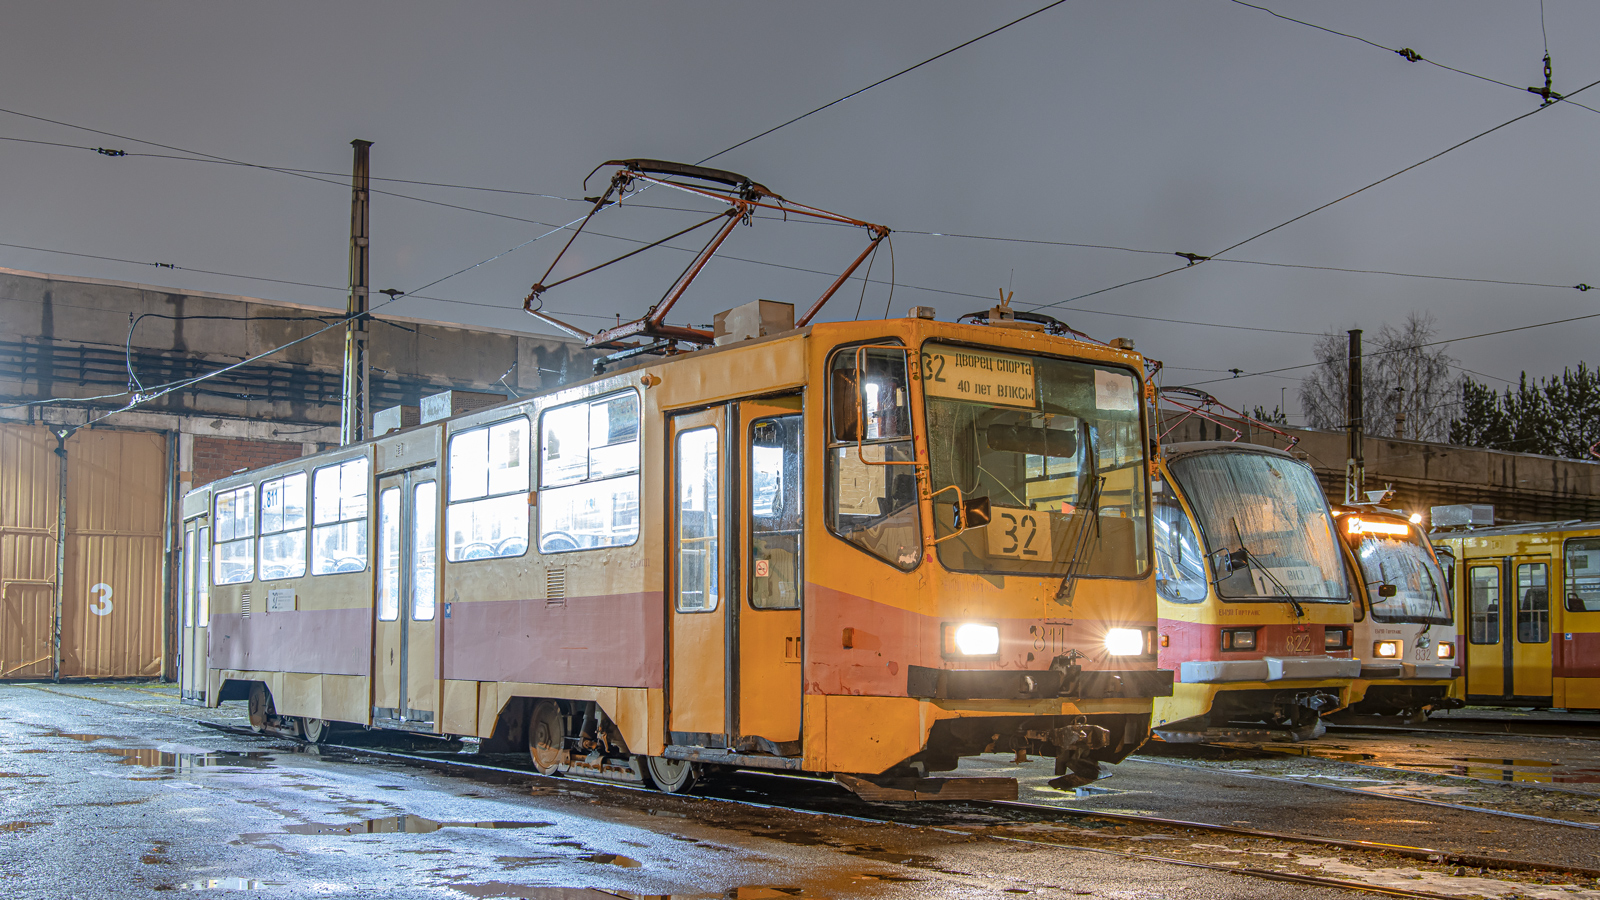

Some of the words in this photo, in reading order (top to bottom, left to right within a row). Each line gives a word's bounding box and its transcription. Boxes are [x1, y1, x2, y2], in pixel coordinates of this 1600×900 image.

[922, 352, 946, 382] 32
[957, 380, 971, 393] 40
[974, 383, 992, 395] лет
[998, 384, 1034, 400] ВЛКСМ
[266, 489, 278, 508] 811
[1001, 513, 1038, 556] 32
[1259, 576, 1267, 595] 1
[90, 582, 113, 616] 3
[1031, 625, 1063, 652] 811
[1286, 634, 1311, 652] 822
[1415, 648, 1431, 661] 832
